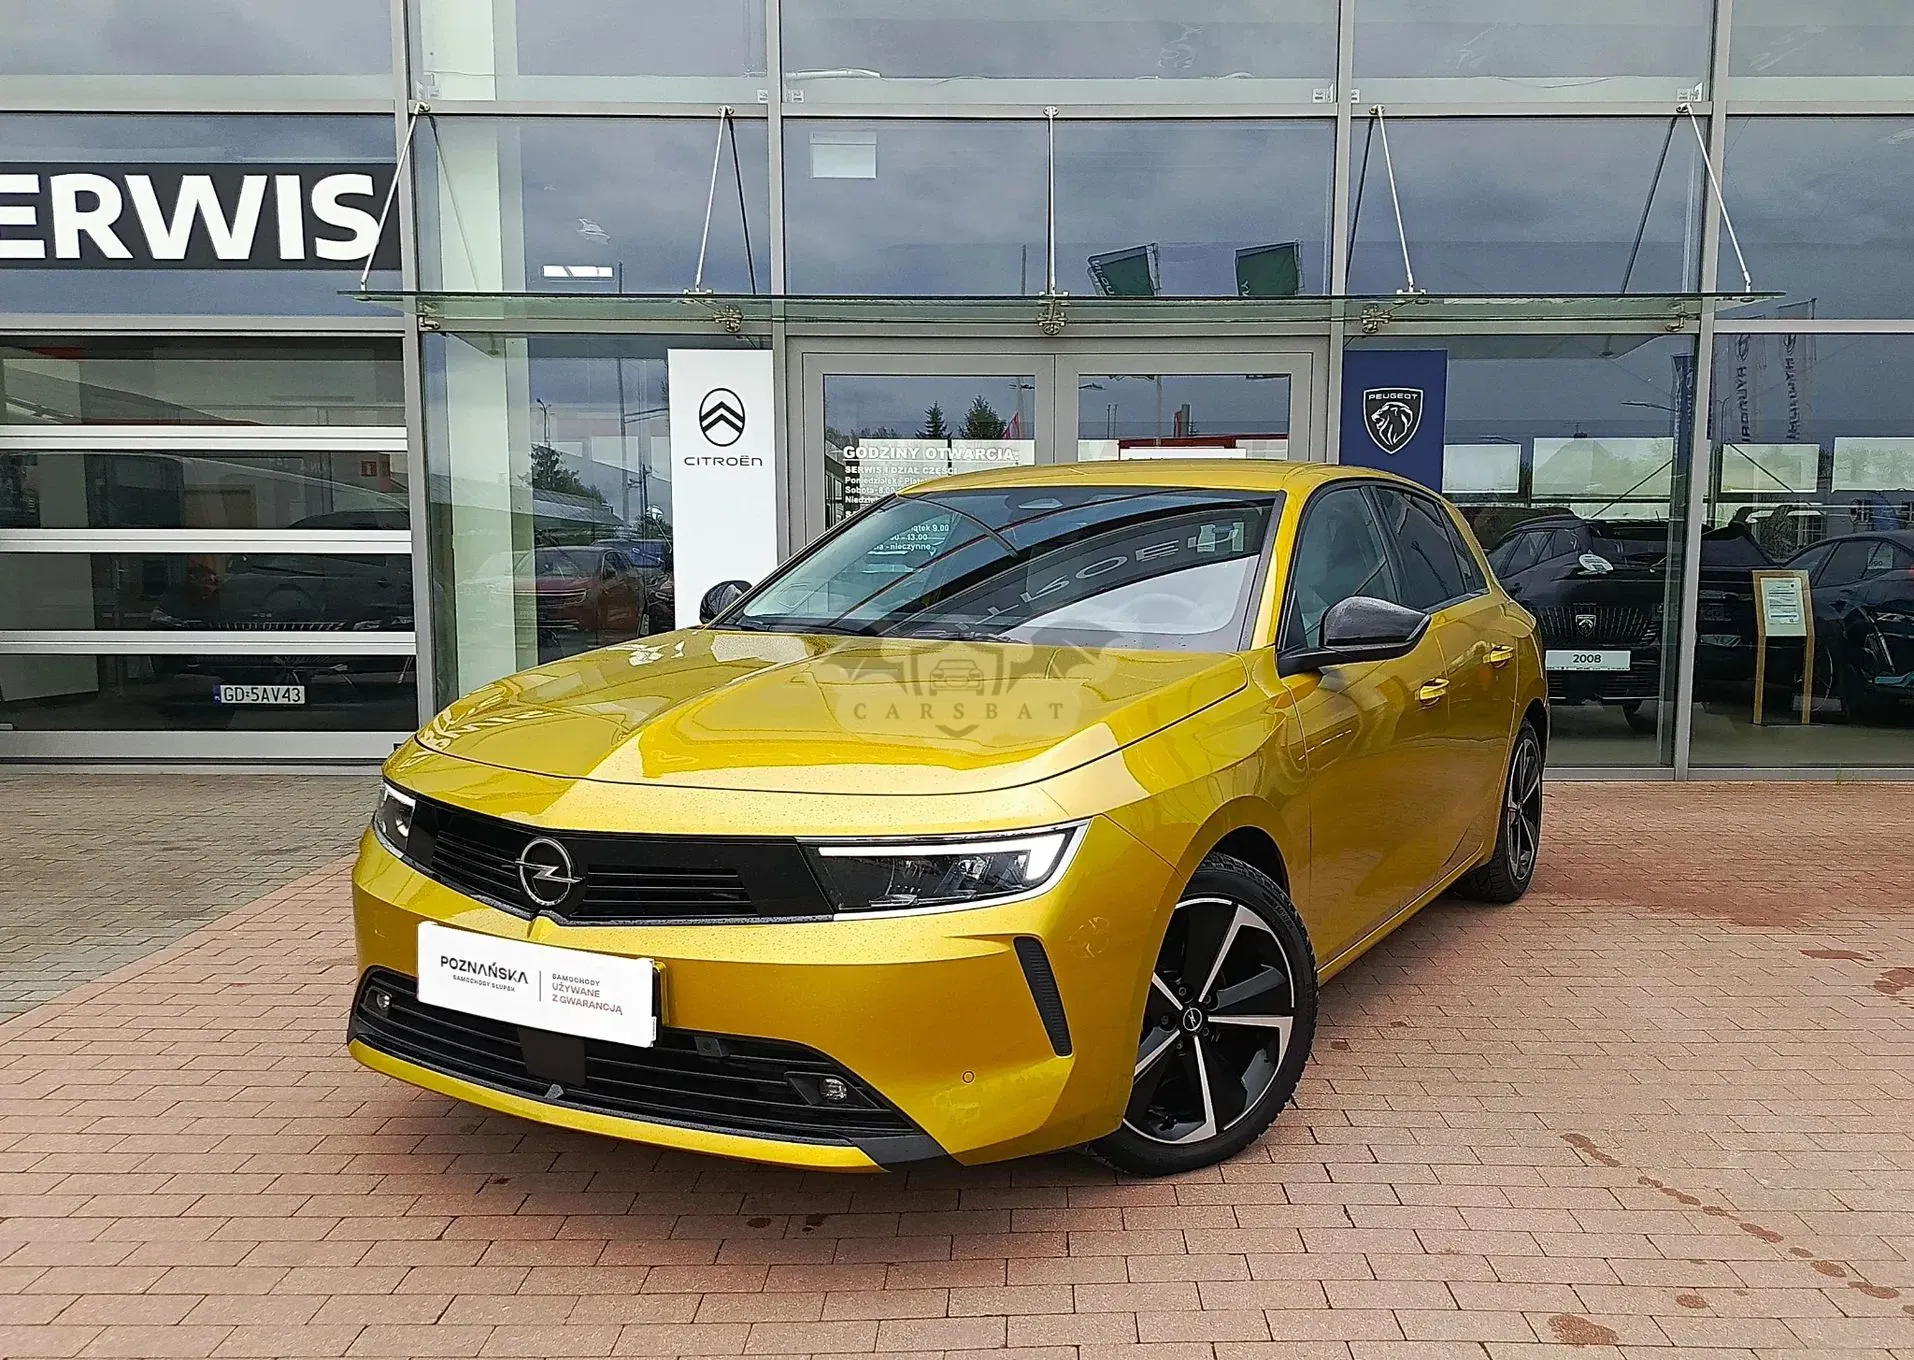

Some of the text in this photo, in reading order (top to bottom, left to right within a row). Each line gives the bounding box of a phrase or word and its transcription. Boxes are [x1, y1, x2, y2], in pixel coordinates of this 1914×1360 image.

[843, 446, 919, 459] GODZINY
[845, 466, 881, 474] SERWIS
[845, 486, 874, 494] Sobota
[1572, 654, 1602, 663] 2008
[224, 687, 301, 702] GD 5AV43
[440, 955, 529, 985] POZNAŃSKA
[552, 973, 601, 987] SAMOCHODY
[552, 982, 601, 998] UŻYWANE
[552, 994, 623, 1015] Z GWARANCJĄ
